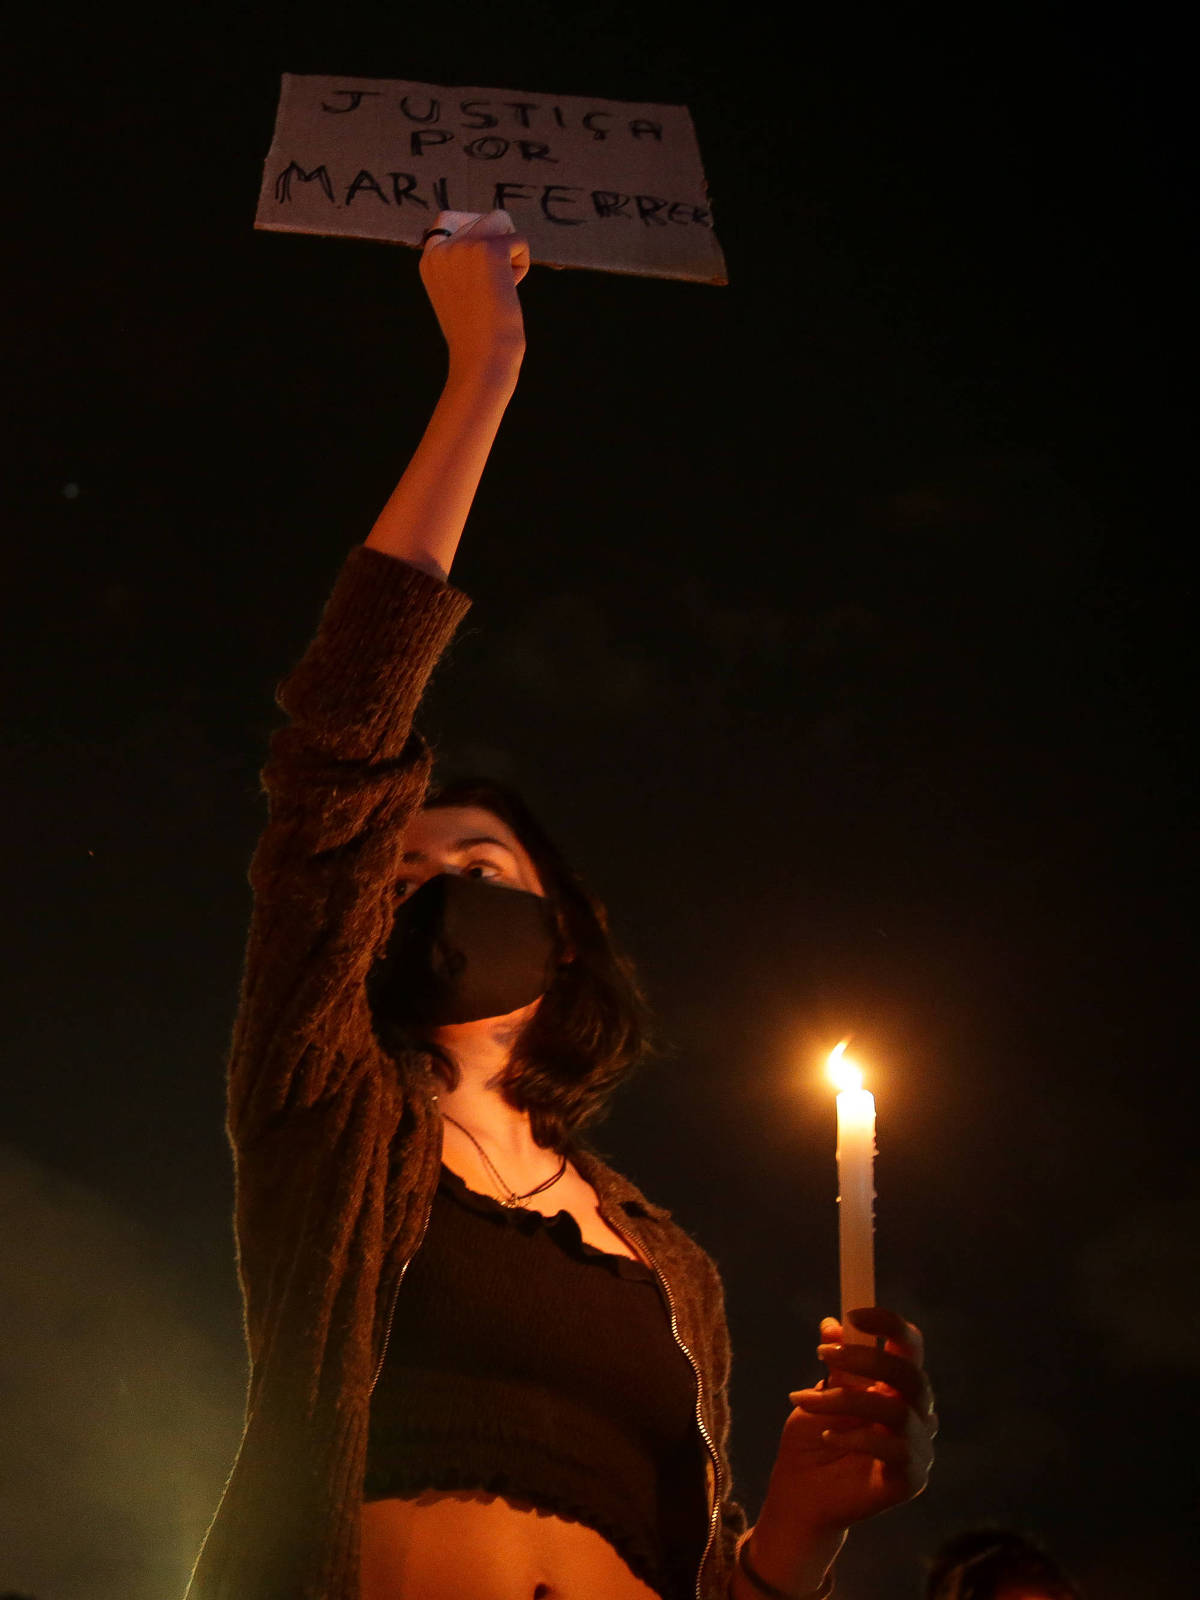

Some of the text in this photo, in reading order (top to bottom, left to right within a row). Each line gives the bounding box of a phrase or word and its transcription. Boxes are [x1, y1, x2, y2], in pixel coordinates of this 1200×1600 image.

[322, 90, 663, 141] JUSTIÇA
[411, 130, 558, 163] POR
[275, 161, 450, 211] MARI
